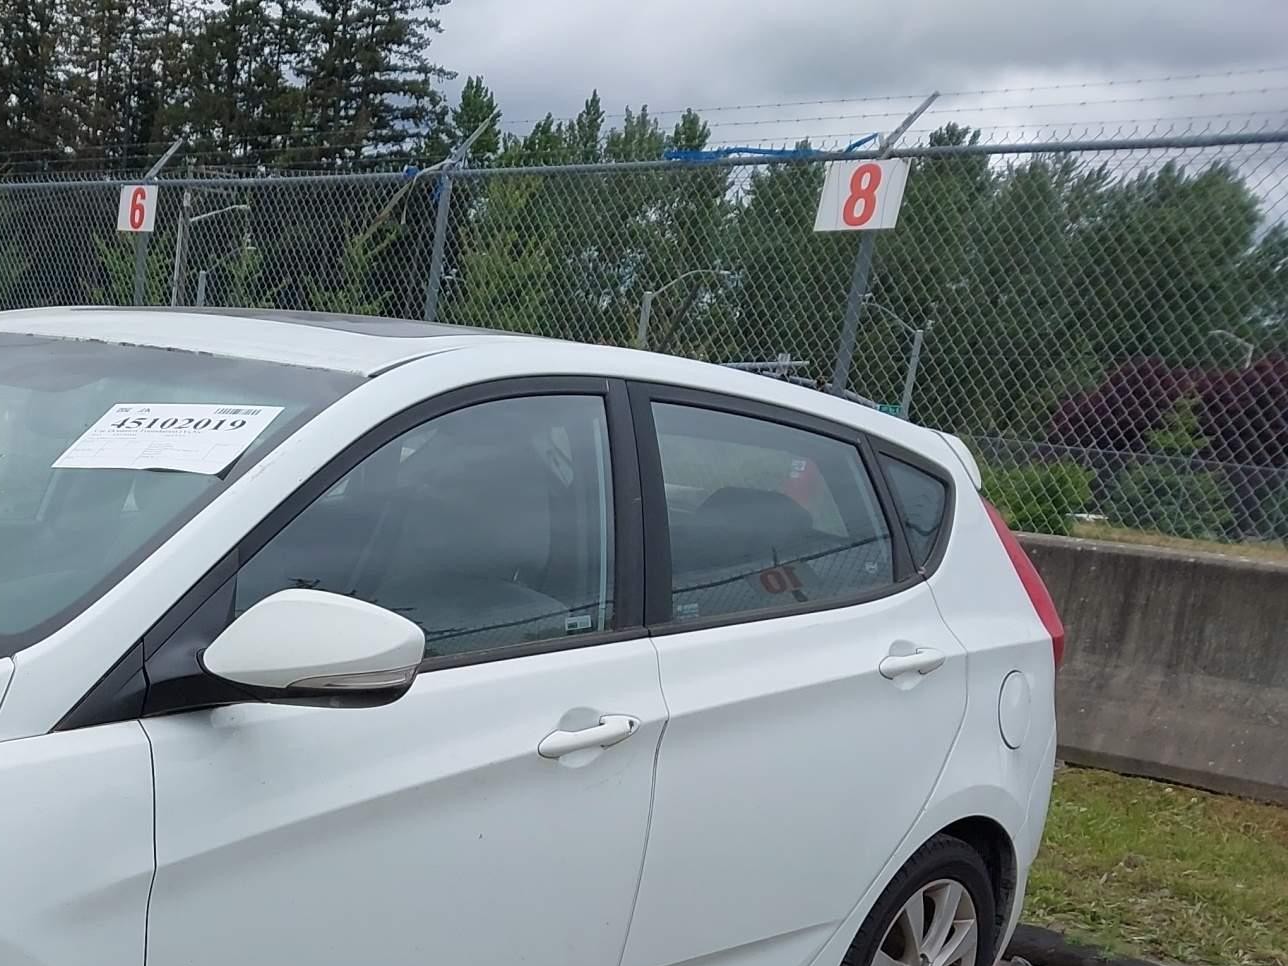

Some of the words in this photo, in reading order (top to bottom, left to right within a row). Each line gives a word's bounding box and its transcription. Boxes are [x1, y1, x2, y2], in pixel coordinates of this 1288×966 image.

[129, 187, 147, 229] 6
[842, 163, 882, 227] 8
[111, 416, 247, 432] 45102019
